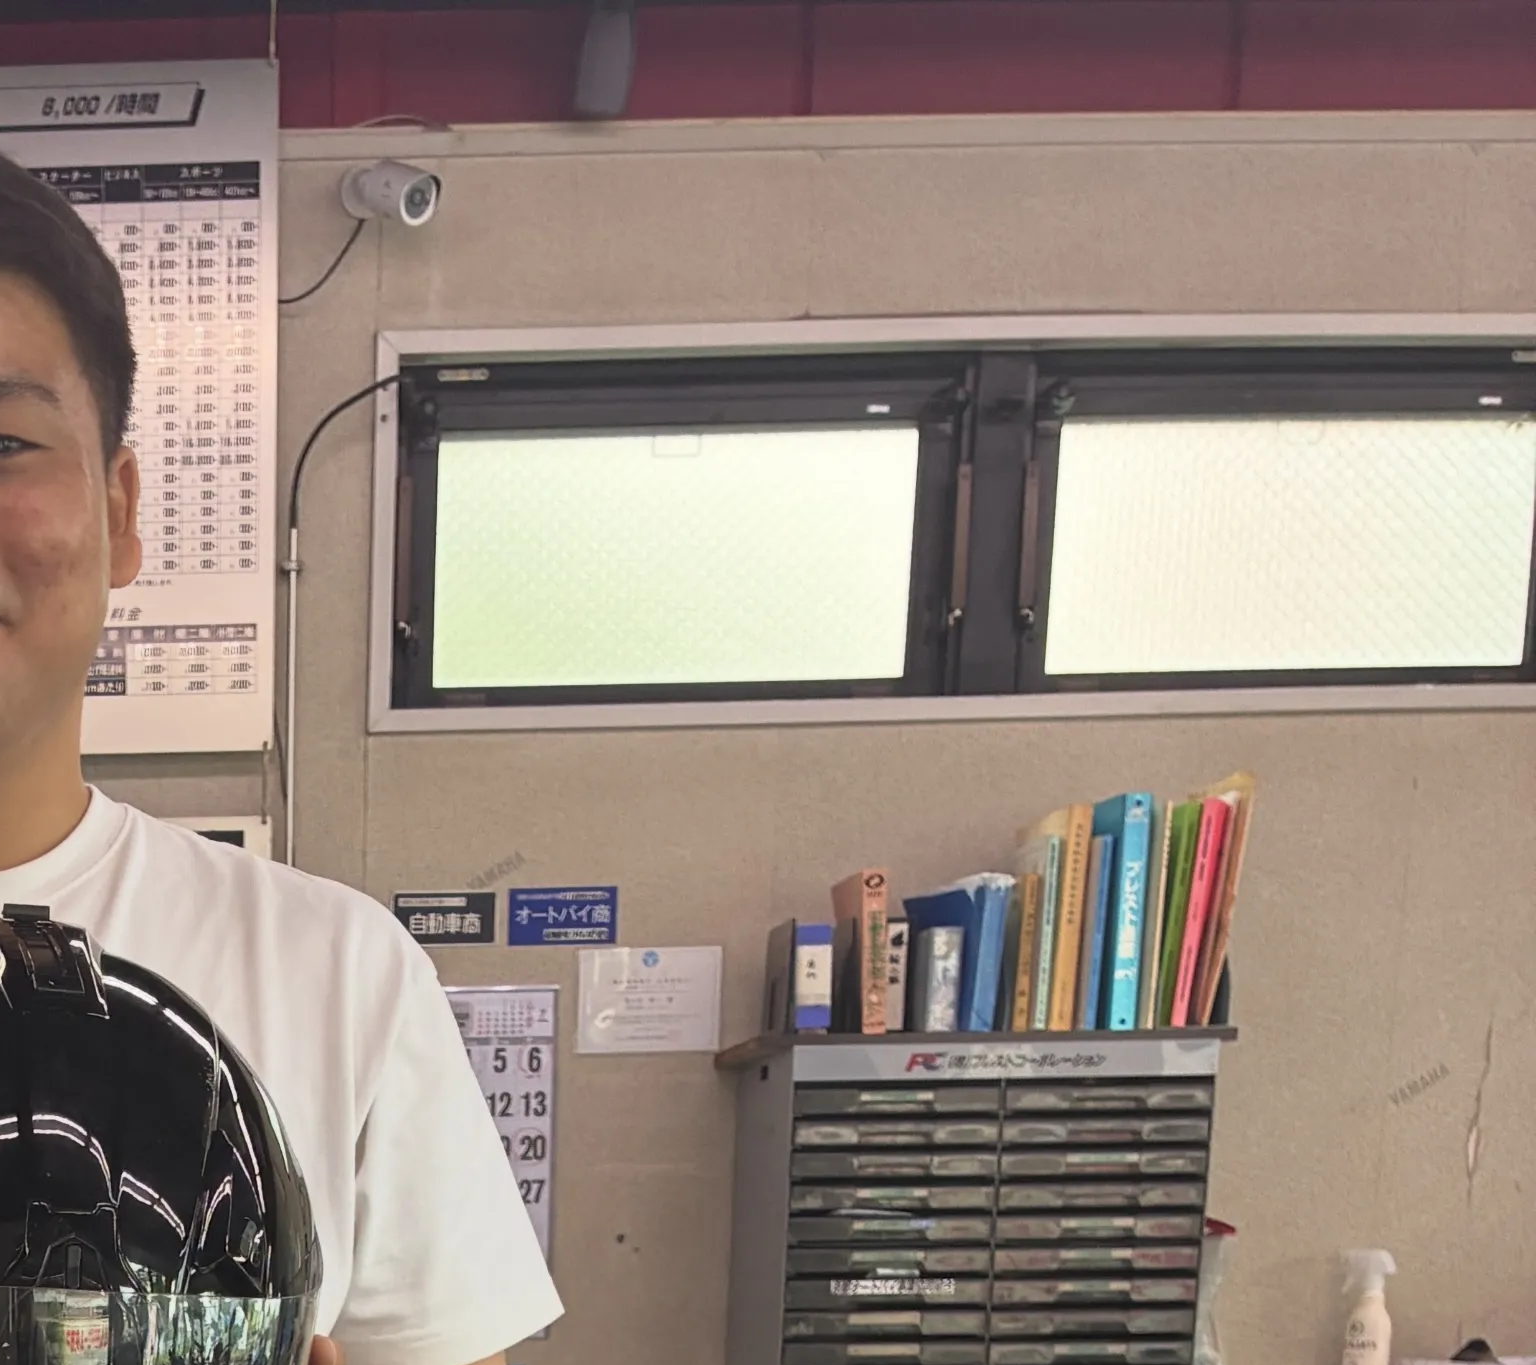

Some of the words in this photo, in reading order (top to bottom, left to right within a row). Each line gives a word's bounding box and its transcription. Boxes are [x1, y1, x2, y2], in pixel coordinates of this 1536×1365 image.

[408, 912, 482, 935] 自動車商
[515, 905, 611, 925] オートバイ商
[493, 1047, 507, 1073] 5
[528, 1046, 542, 1073] 6
[486, 1091, 514, 1117] 12
[520, 1090, 547, 1117] 13
[520, 1135, 547, 1161] 20
[519, 1179, 546, 1204] 27
